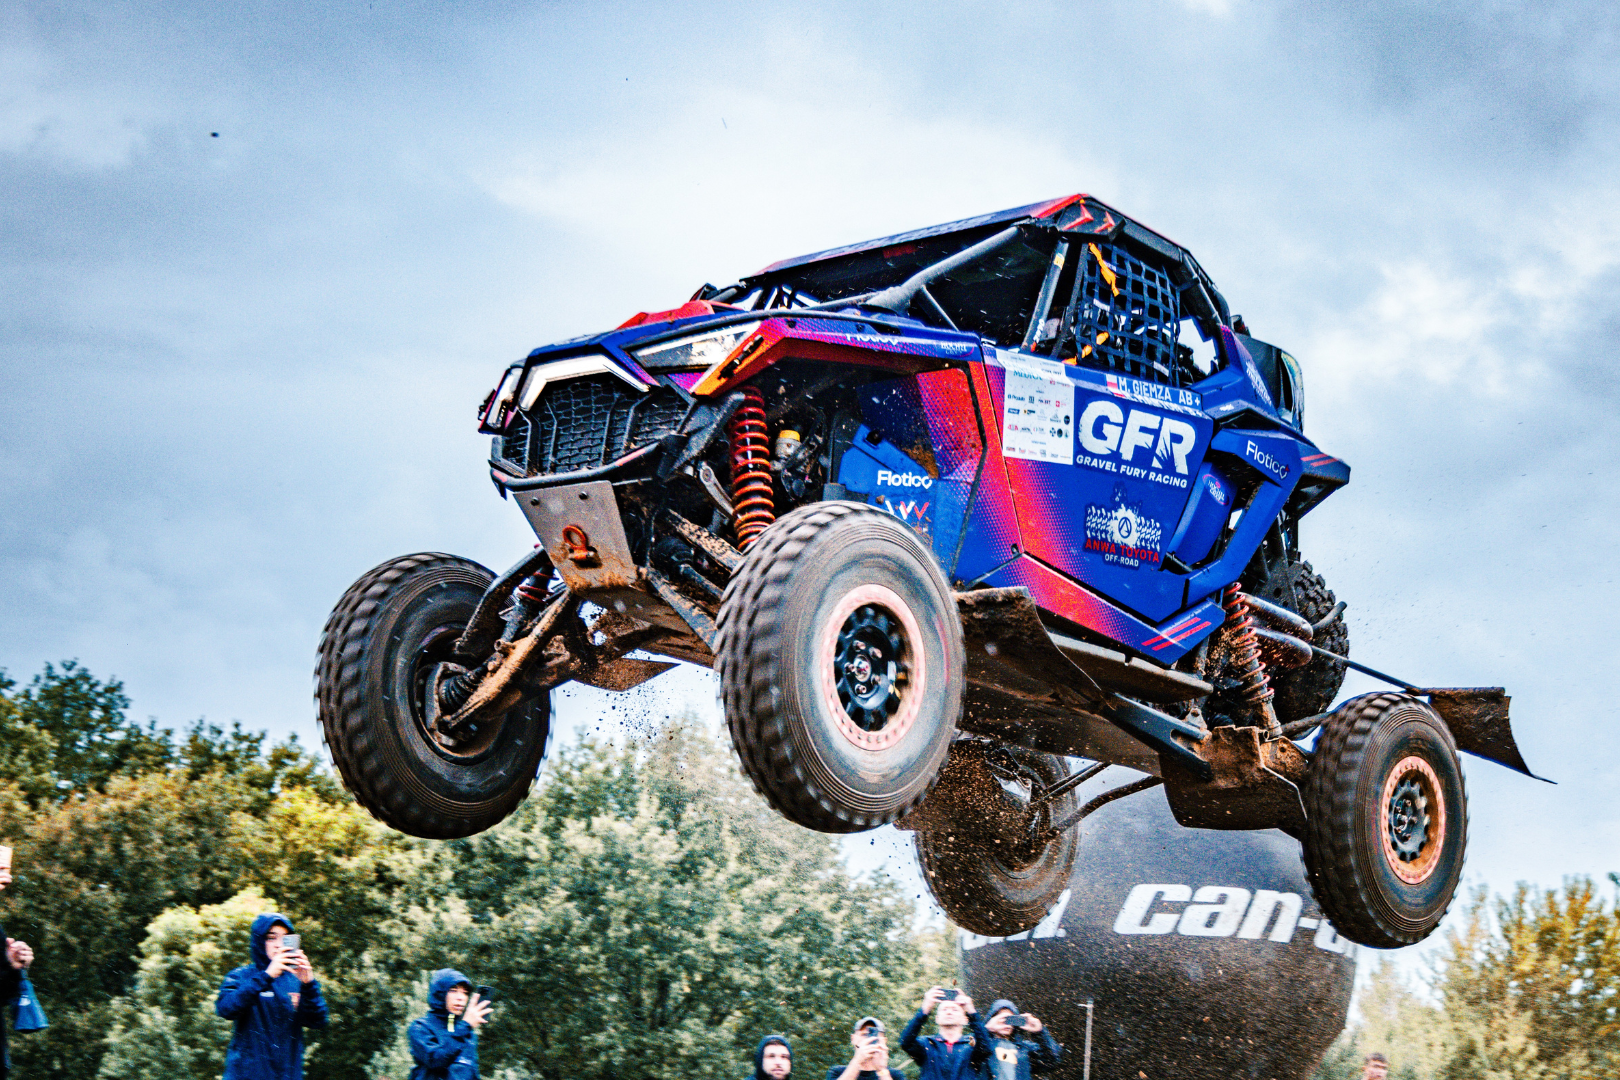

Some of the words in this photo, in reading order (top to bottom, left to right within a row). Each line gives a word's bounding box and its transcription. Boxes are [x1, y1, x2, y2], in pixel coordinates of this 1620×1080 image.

[1132, 380, 1172, 402] GIEMZA
[1078, 400, 1196, 476] GFR
[1076, 454, 1117, 473] GRAVEL
[1119, 465, 1148, 479] FURY
[1149, 472, 1188, 489] RACING
[1085, 538, 1116, 554] ANWA
[1120, 545, 1160, 563] TOYOTA
[1104, 553, 1139, 567] OFF-ROAD
